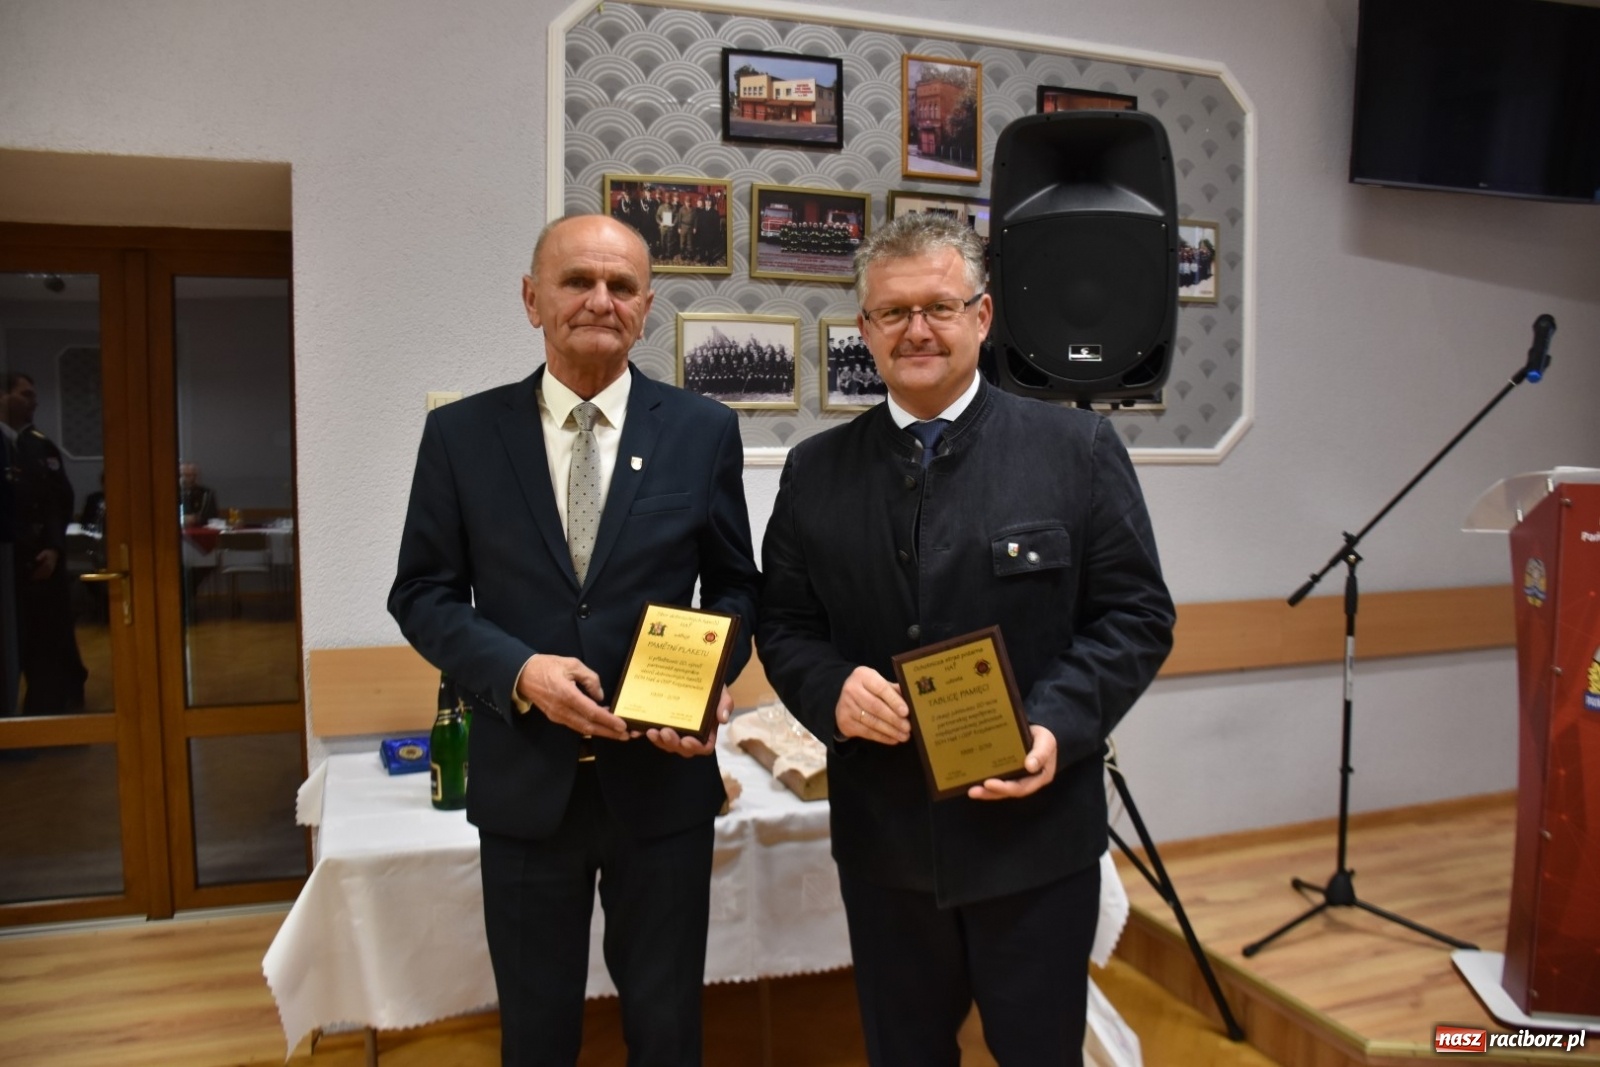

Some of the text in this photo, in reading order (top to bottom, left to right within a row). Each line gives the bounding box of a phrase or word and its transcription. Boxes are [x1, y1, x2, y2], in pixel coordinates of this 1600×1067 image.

[647, 640, 709, 656] PAMĚTNÍ PLAKETU
[928, 683, 990, 707] TABLICĘ PAMIĘCI
